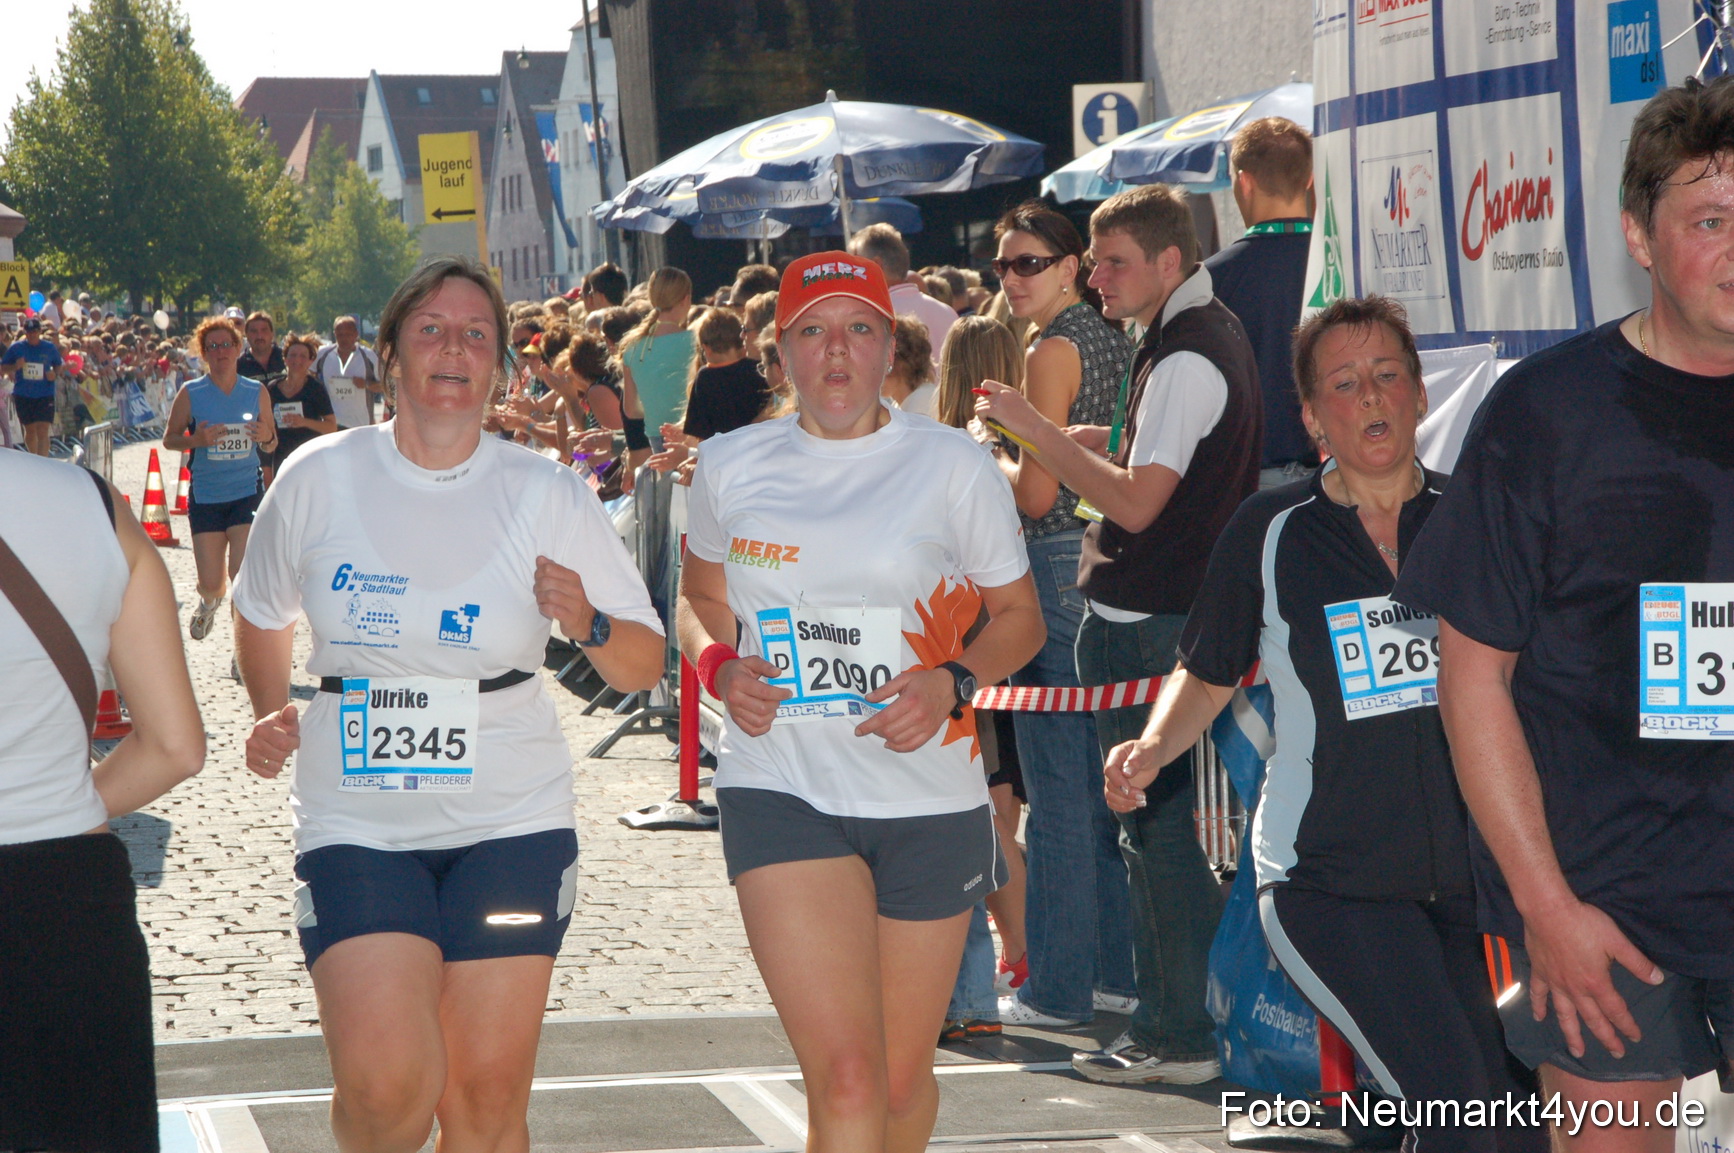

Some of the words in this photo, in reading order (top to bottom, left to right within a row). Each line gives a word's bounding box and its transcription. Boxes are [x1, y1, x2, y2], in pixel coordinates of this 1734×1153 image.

[1611, 11, 1650, 58] maxi
[1641, 52, 1659, 83] dsl
[424, 156, 473, 174] Jugend
[440, 173, 465, 188] lauf
[1462, 147, 1553, 261] Charivari
[0, 263, 26, 272] Block
[1493, 250, 1540, 273] Ostbayerns
[1543, 246, 1564, 268] Radio
[803, 262, 867, 281] MERZ
[4, 275, 22, 298] A
[219, 439, 248, 451] 3281
[727, 547, 781, 571] Reisen
[731, 537, 800, 563] MERZ
[331, 563, 355, 591] 6.
[351, 571, 409, 585] Neumarkter
[360, 583, 406, 596] Stadtlauf
[440, 629, 470, 643] DKMS
[797, 620, 861, 646] Sabine
[774, 653, 790, 671] D
[1343, 642, 1360, 661] D
[1654, 643, 1674, 666] B
[807, 657, 892, 695] 2090
[1697, 651, 1734, 696] 3
[371, 688, 428, 709] Ulrike
[1348, 692, 1403, 713] BOCK
[776, 703, 829, 717] BOCK
[347, 720, 359, 738] C
[1644, 715, 1719, 731] BOCK
[372, 726, 467, 761] 2345
[342, 775, 385, 787] BOCK
[420, 775, 472, 785] PFLEIDERER
